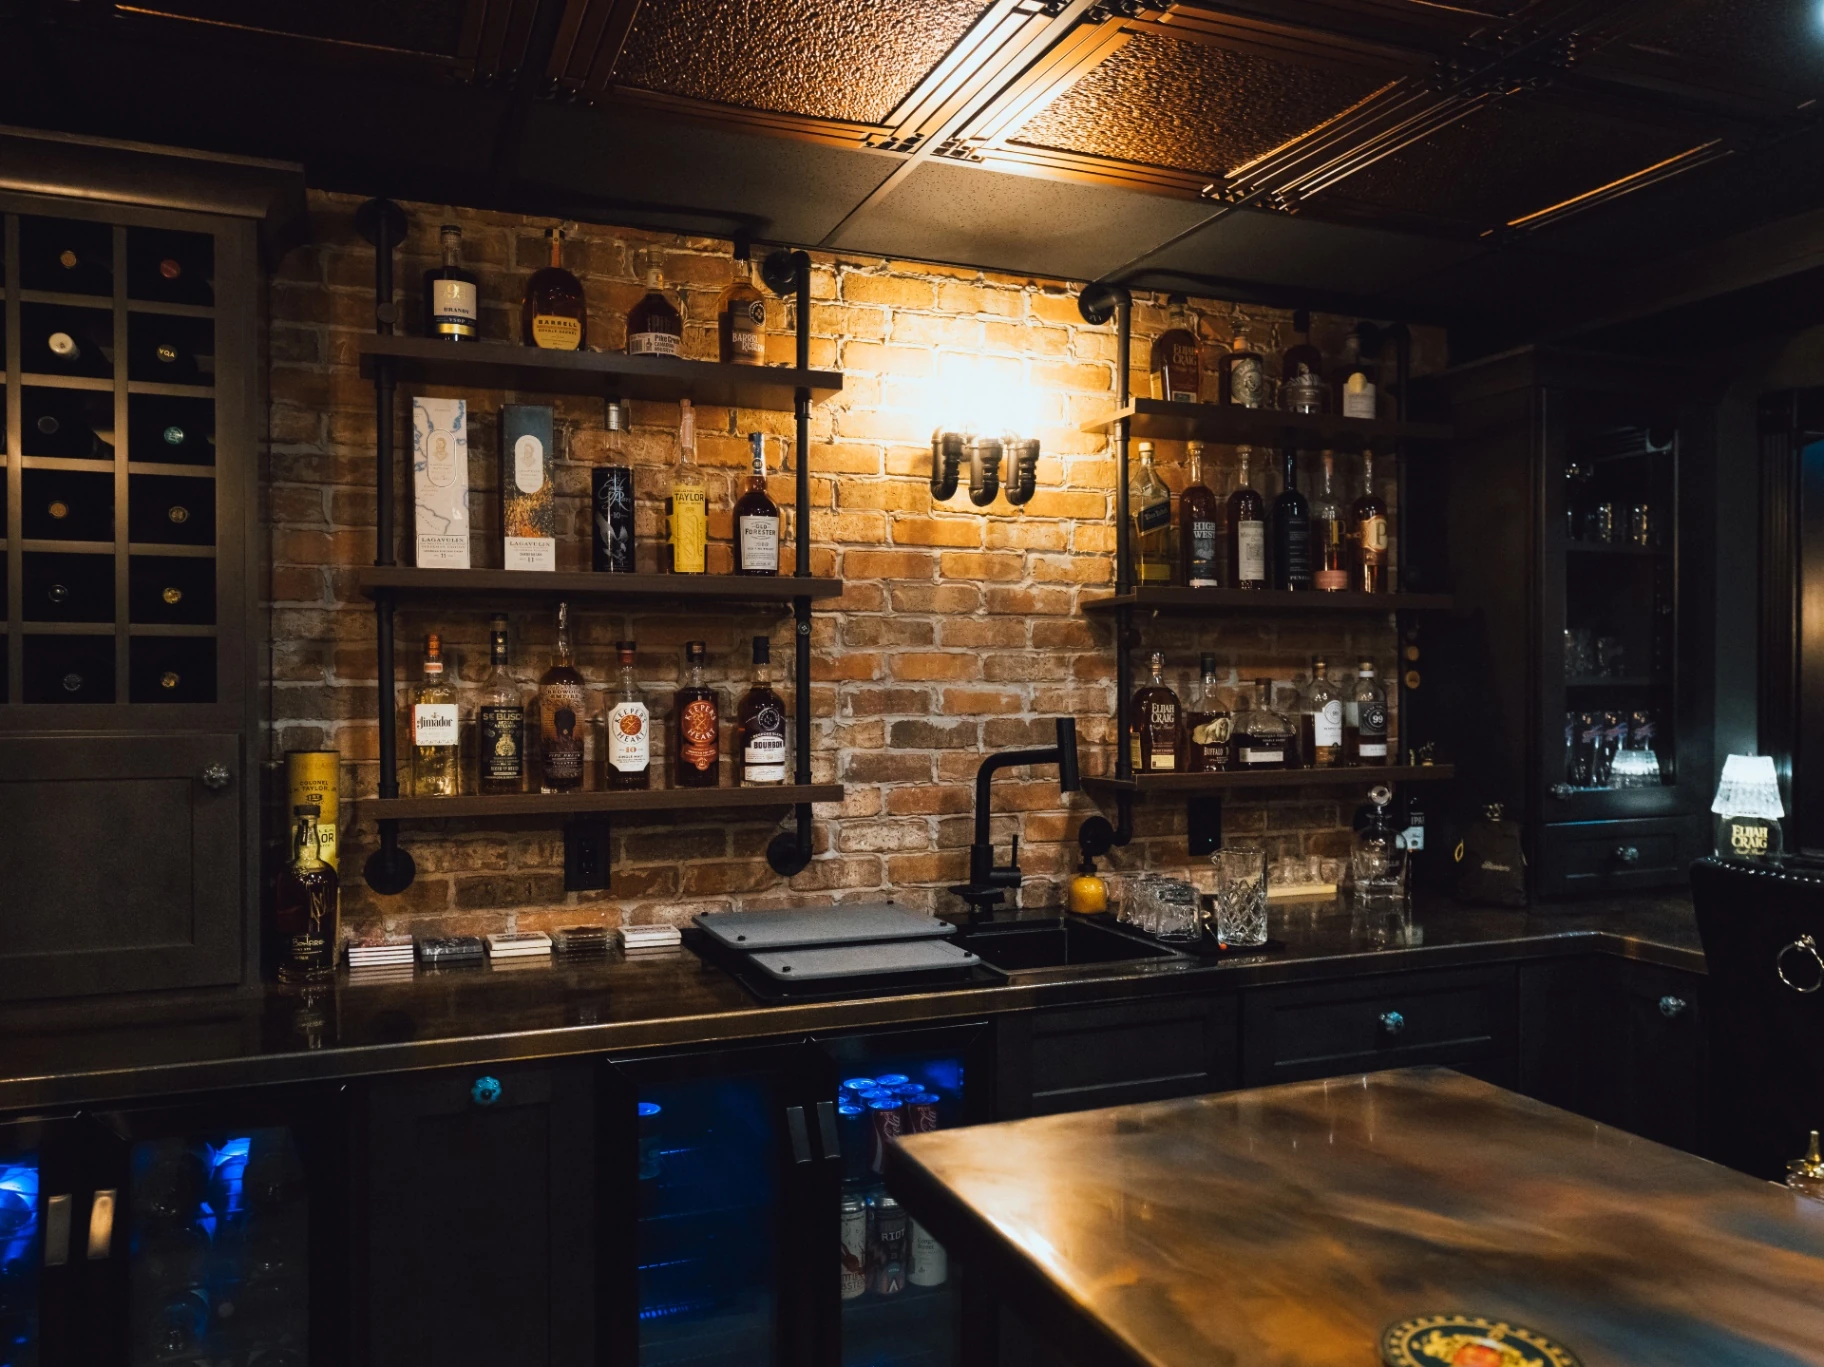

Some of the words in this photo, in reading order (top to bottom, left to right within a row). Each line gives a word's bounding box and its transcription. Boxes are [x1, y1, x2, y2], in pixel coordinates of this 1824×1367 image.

[537, 319, 578, 328] BARRELL
[654, 335, 668, 343] Pike
[732, 332, 759, 343] BARREL
[159, 348, 175, 357] VQA
[674, 492, 704, 502] TAYLOR
[744, 528, 776, 536] FORESTER
[684, 704, 717, 721] KEEPER'S
[1151, 703, 1175, 713] ELIJAH
[1151, 713, 1175, 724] CRAIG
[1372, 715, 1384, 724] 99
[616, 731, 645, 743] HEART
[687, 728, 716, 740] HEART
[753, 740, 783, 749] BOURBON
[1203, 746, 1224, 756] BUFFALO
[1731, 824, 1768, 838] ELIJAH
[1731, 836, 1768, 849] CRAIG
[881, 1228, 906, 1241] RIOT
